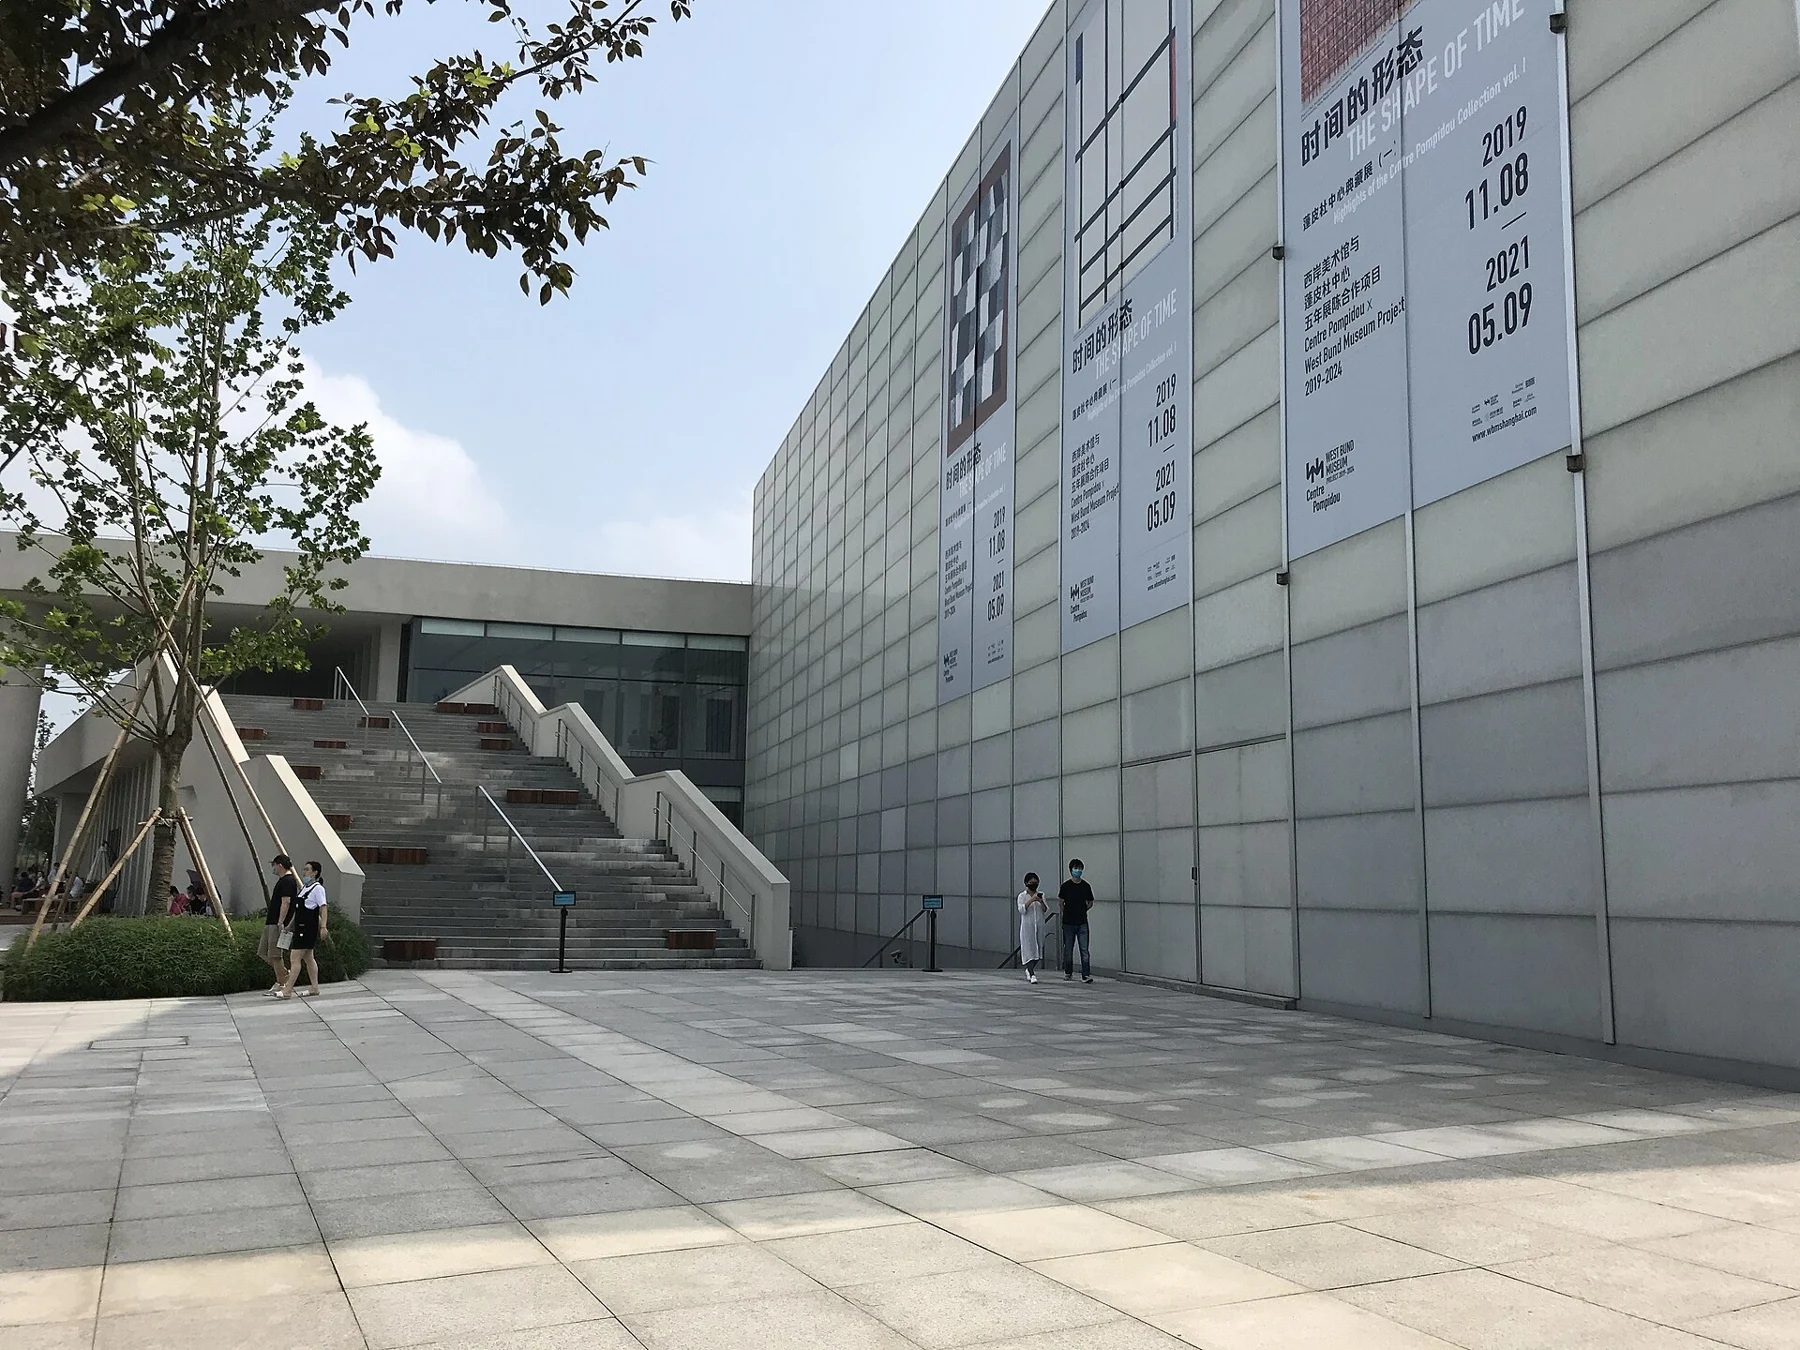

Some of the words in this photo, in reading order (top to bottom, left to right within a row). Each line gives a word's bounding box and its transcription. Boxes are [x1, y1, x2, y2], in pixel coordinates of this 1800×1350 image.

[1302, 26, 1423, 167] 时间的形态
[1347, 110, 1376, 161] THE
[1381, 56, 1437, 132] SHAPE
[1444, 28, 1468, 78] OF
[1473, 0, 1525, 52] TIME
[1333, 189, 1367, 225] Highlights
[1367, 178, 1376, 197] of
[1376, 173, 1388, 190] the
[1416, 118, 1456, 159] Pompidou
[1457, 81, 1501, 125] Collection
[1503, 64, 1520, 88] vol.
[1482, 106, 1527, 168] 2019
[1465, 152, 1528, 230] 11.08
[1304, 235, 1360, 289] 西岸美术馆与
[1486, 234, 1529, 292] 2021
[1304, 265, 1351, 311] 蓬皮杜中心
[1305, 265, 1381, 332] 五年展陈合作项目
[1072, 299, 1132, 374] 时间的形态
[1096, 348, 1109, 380] THE
[1141, 309, 1152, 340] OF
[1154, 287, 1177, 328] TIME
[1304, 328, 1328, 353] Centre
[1328, 303, 1365, 337] Pompidou
[1304, 351, 1322, 375] West
[1323, 337, 1342, 363] Bund
[1343, 320, 1376, 351] Museum
[1377, 296, 1405, 328] Project
[1468, 282, 1533, 355] 05.09
[1156, 373, 1176, 408] 2019
[1305, 360, 1343, 397] 2019-2024
[1147, 403, 1176, 448] 11.08
[1155, 459, 1175, 492] 2021
[1306, 485, 1325, 502] Centre
[993, 505, 1006, 529] 2019
[1147, 490, 1176, 532] 05.09
[1312, 492, 1341, 514] Pompidou
[989, 528, 1006, 559] 11.08
[993, 570, 1005, 593] 2021
[987, 593, 1005, 622] 05.09
